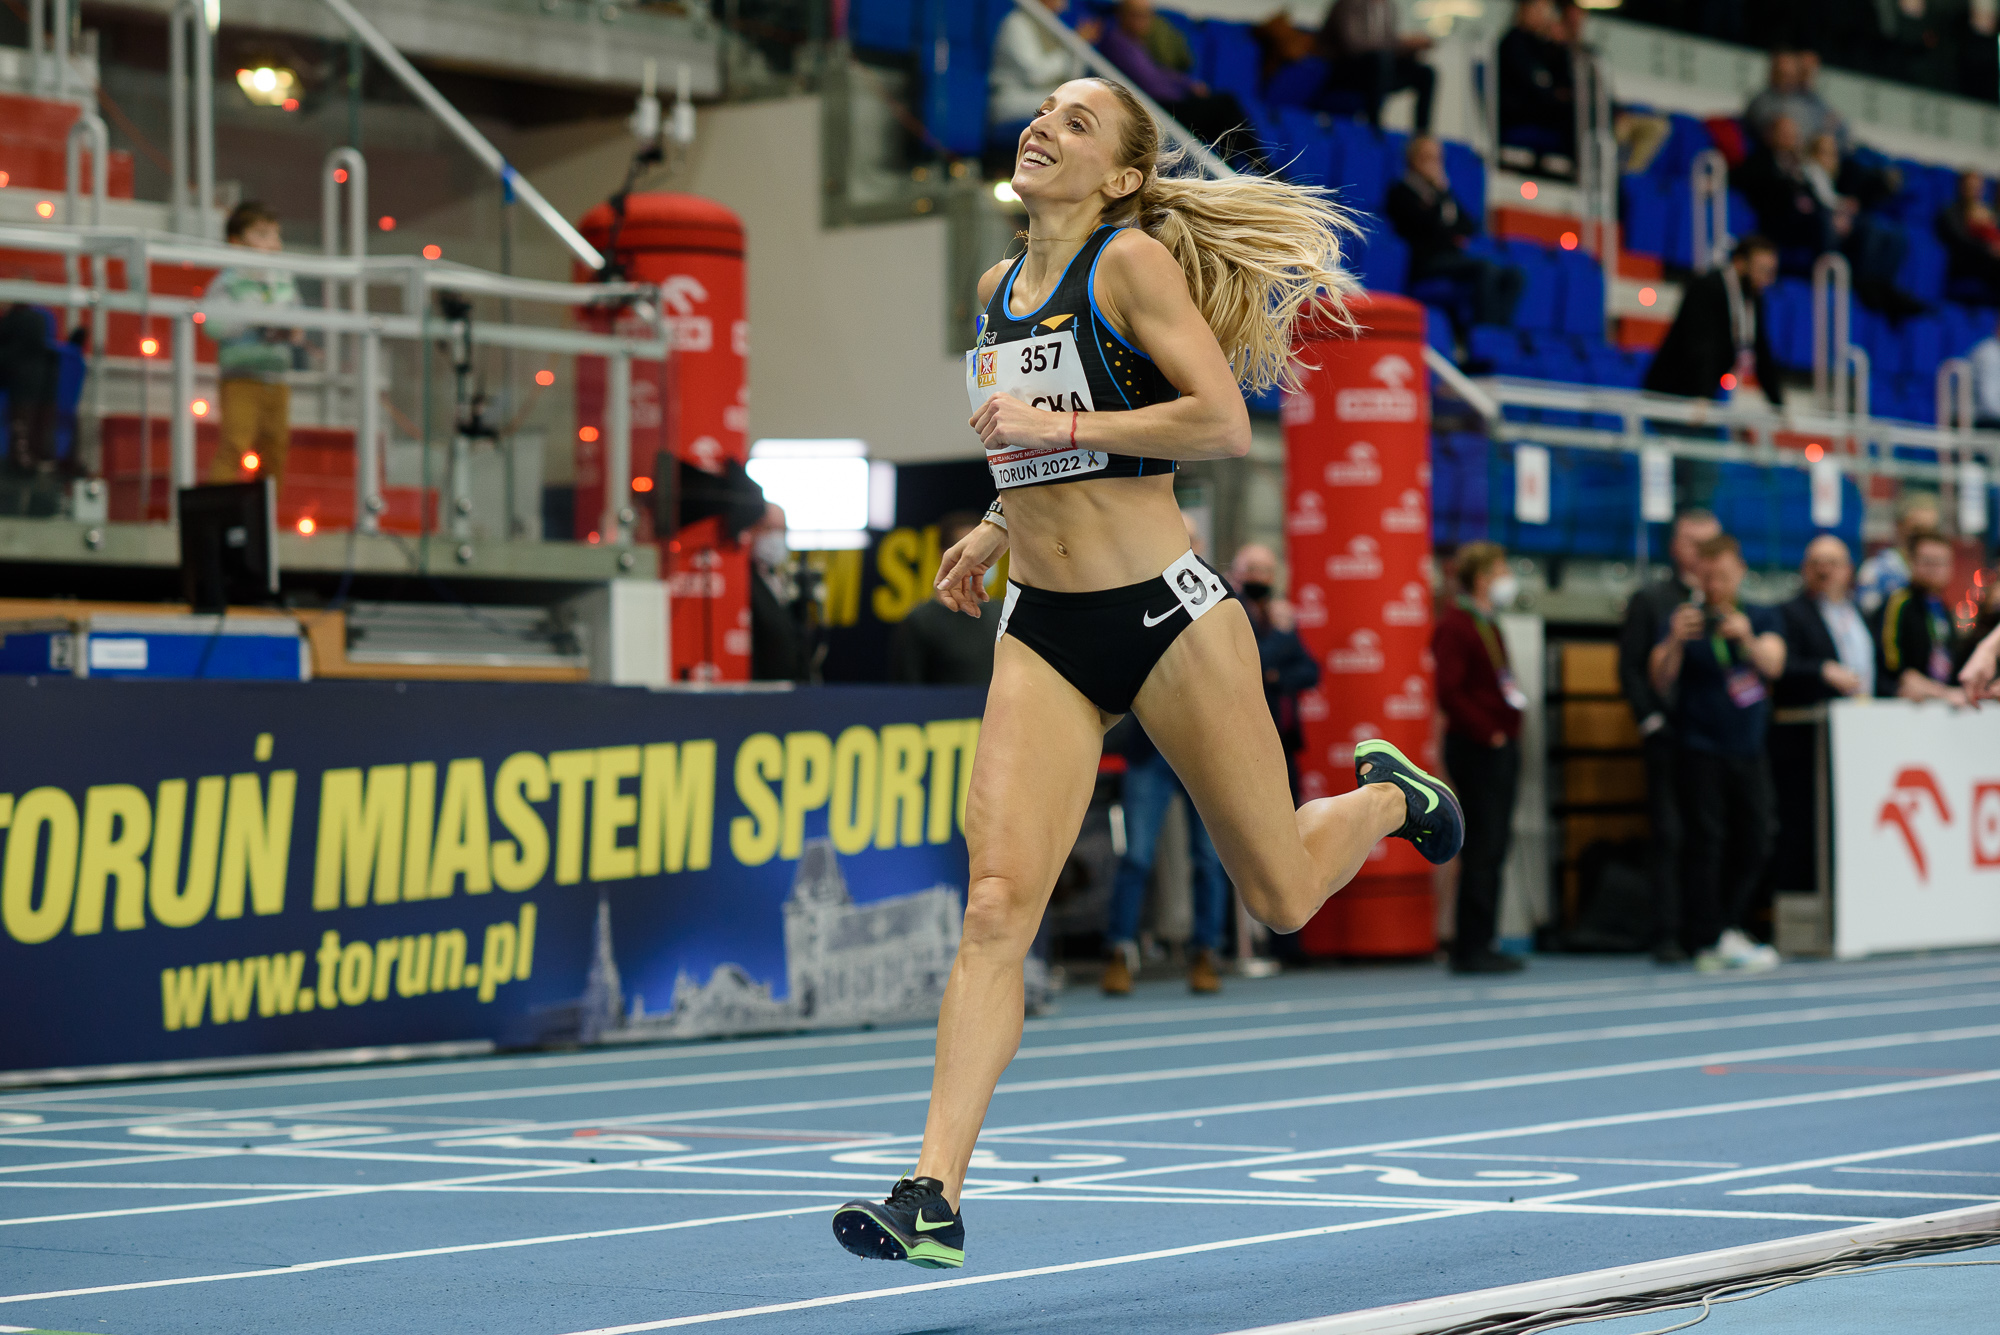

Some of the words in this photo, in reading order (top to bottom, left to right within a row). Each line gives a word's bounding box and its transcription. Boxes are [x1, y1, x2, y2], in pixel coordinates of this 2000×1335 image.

[1020, 341, 1062, 374] 357
[999, 460, 1038, 484] TORUŃ
[1042, 456, 1082, 477] 2022
[313, 739, 716, 912] MIASTEM
[161, 902, 538, 1032] www.torun.pl
